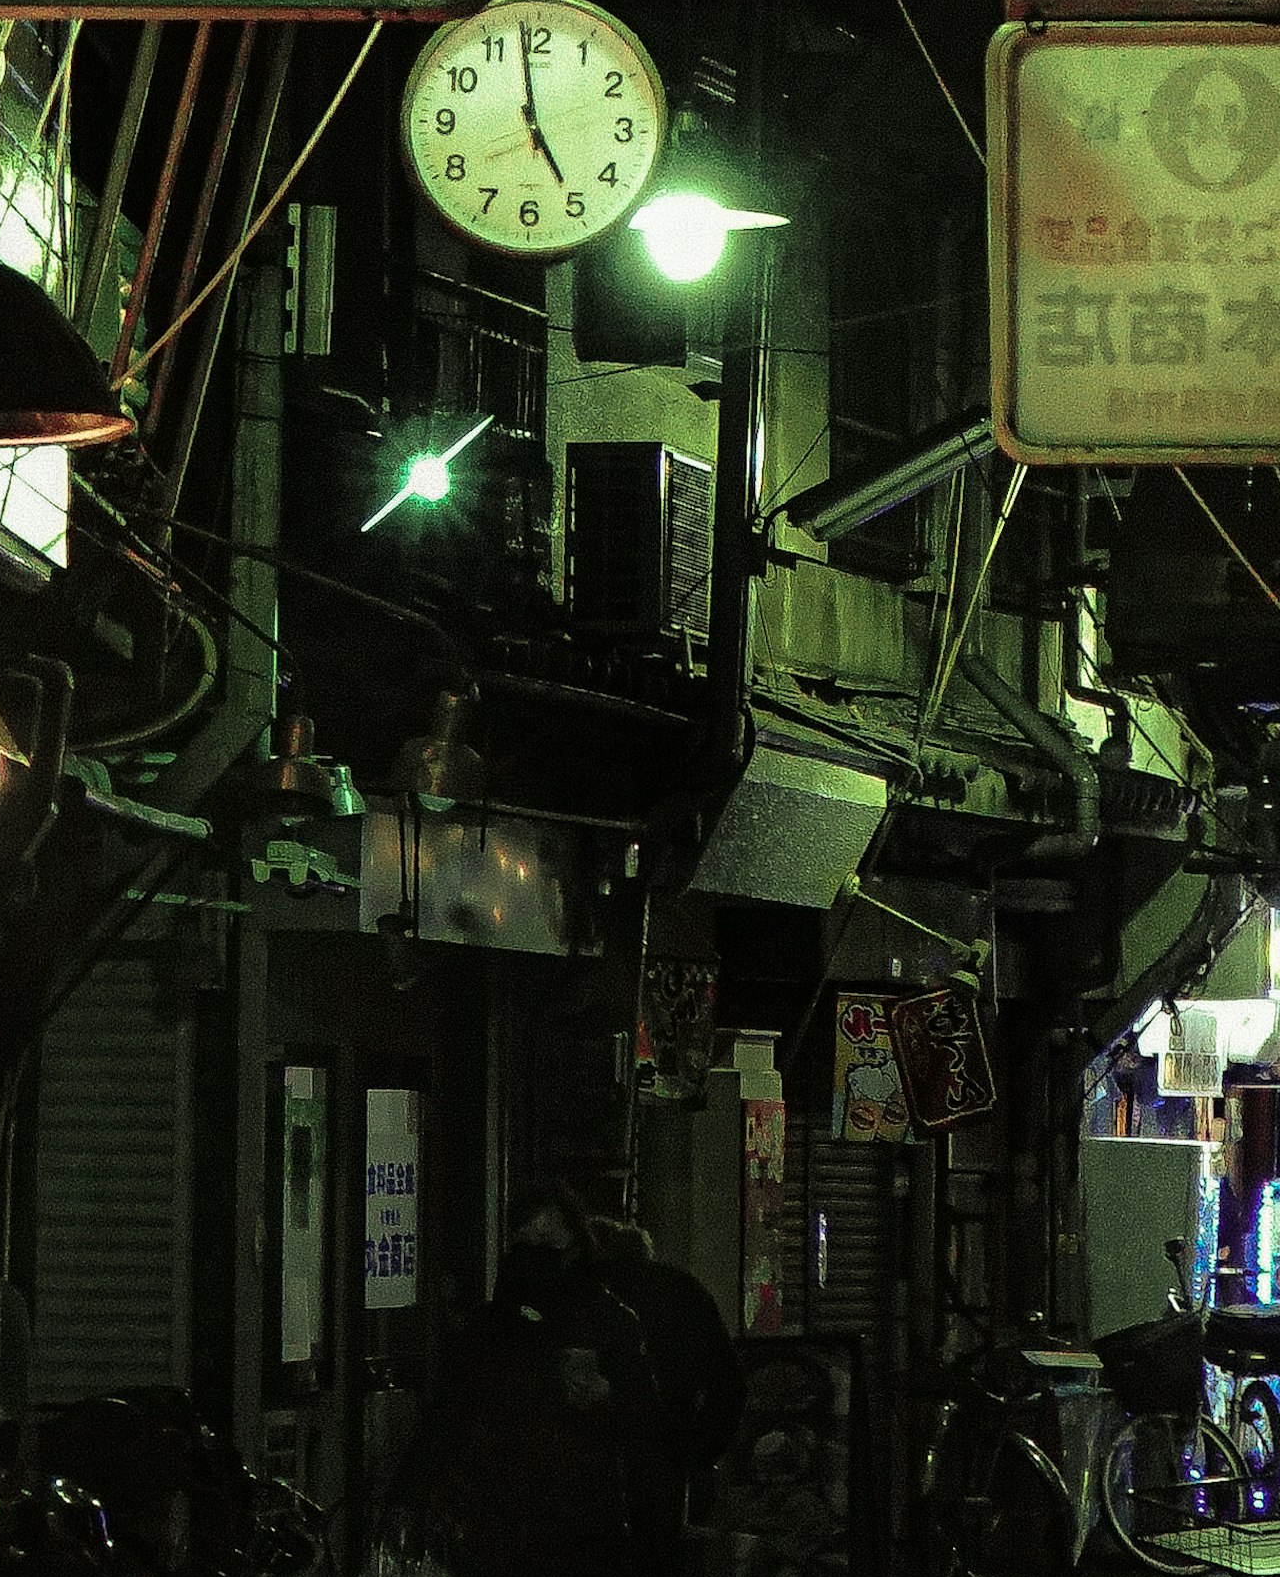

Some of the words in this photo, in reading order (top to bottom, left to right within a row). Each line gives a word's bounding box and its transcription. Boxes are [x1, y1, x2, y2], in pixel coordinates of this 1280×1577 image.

[481, 36, 505, 63] 11
[525, 27, 552, 55] 12
[577, 41, 589, 65] 1
[446, 66, 478, 94] 10
[604, 72, 625, 98] 2
[435, 108, 456, 135] 9
[614, 117, 634, 142] 3
[444, 153, 466, 181] 8
[597, 162, 619, 187] 4
[478, 187, 499, 214] 7
[519, 200, 539, 226] 6
[565, 191, 585, 217] 5
